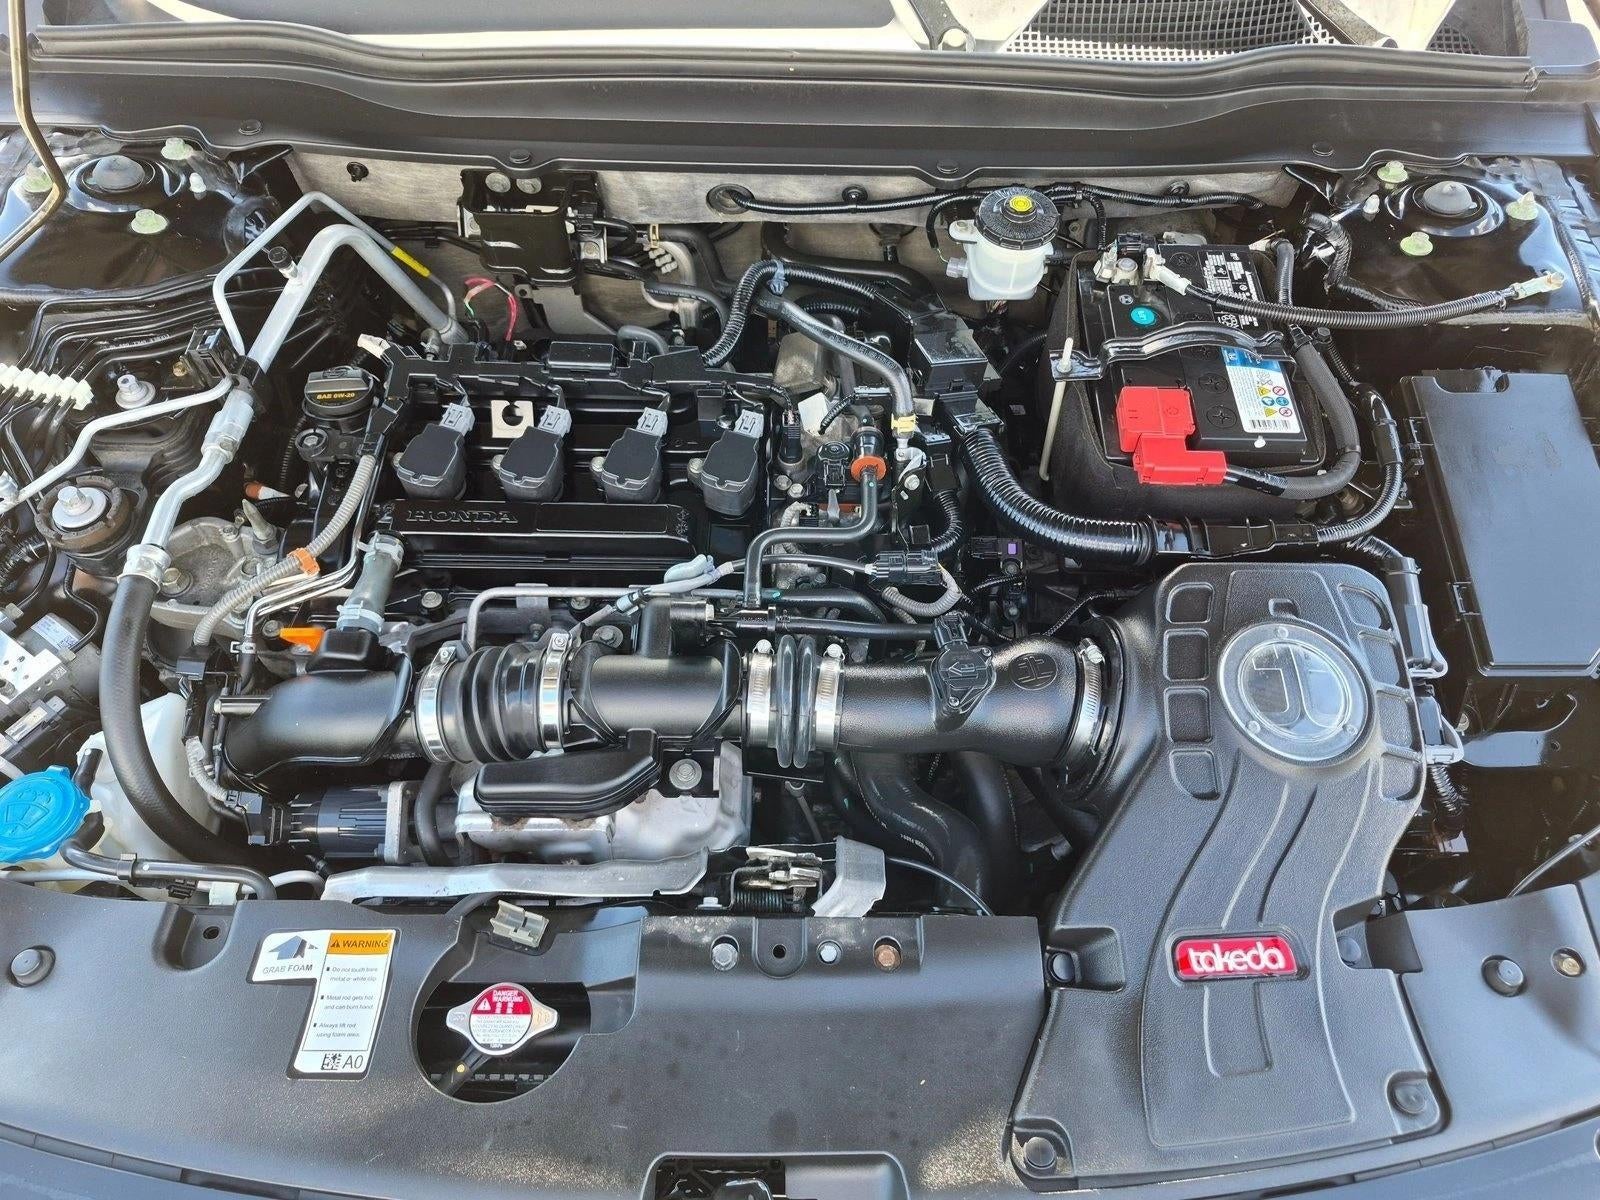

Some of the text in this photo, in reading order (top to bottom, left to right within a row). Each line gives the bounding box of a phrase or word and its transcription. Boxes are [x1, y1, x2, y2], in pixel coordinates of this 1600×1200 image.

[406, 510, 519, 523] HONDA
[342, 939, 389, 949] WARNING
[1188, 941, 1286, 974] takeda
[263, 964, 313, 974] GRAB FOAM
[342, 1055, 364, 1070] A0
